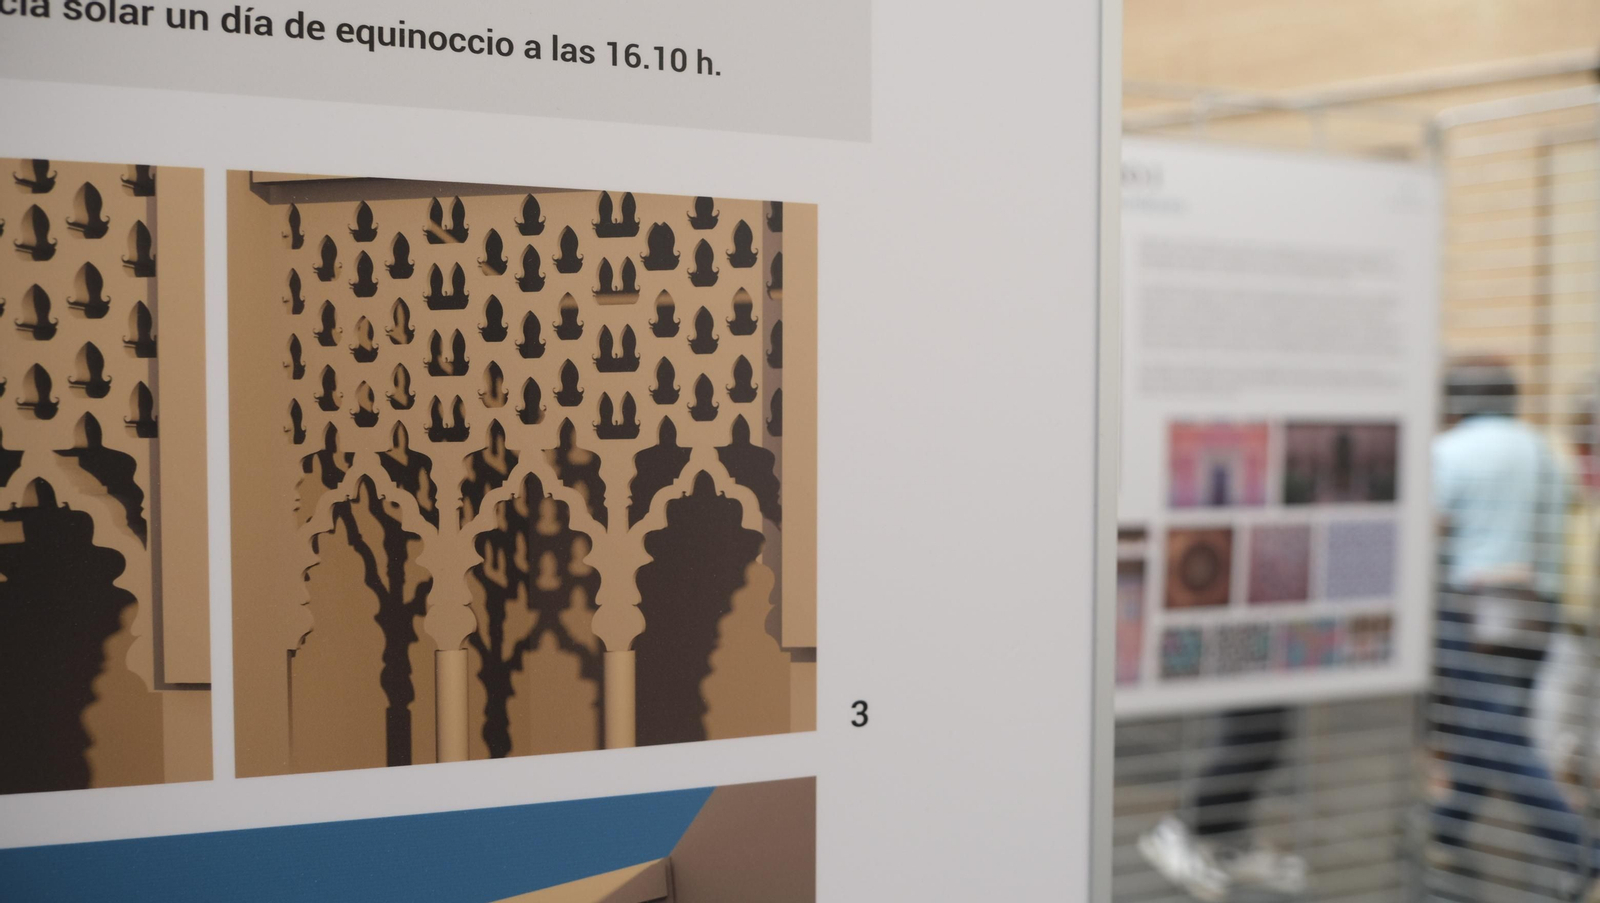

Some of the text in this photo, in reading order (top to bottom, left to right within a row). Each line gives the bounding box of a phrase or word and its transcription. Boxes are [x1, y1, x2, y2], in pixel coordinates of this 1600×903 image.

[0, 0, 721, 77] cia solar un día de equinoccio a las 16.10 h.
[851, 700, 869, 728] 3
